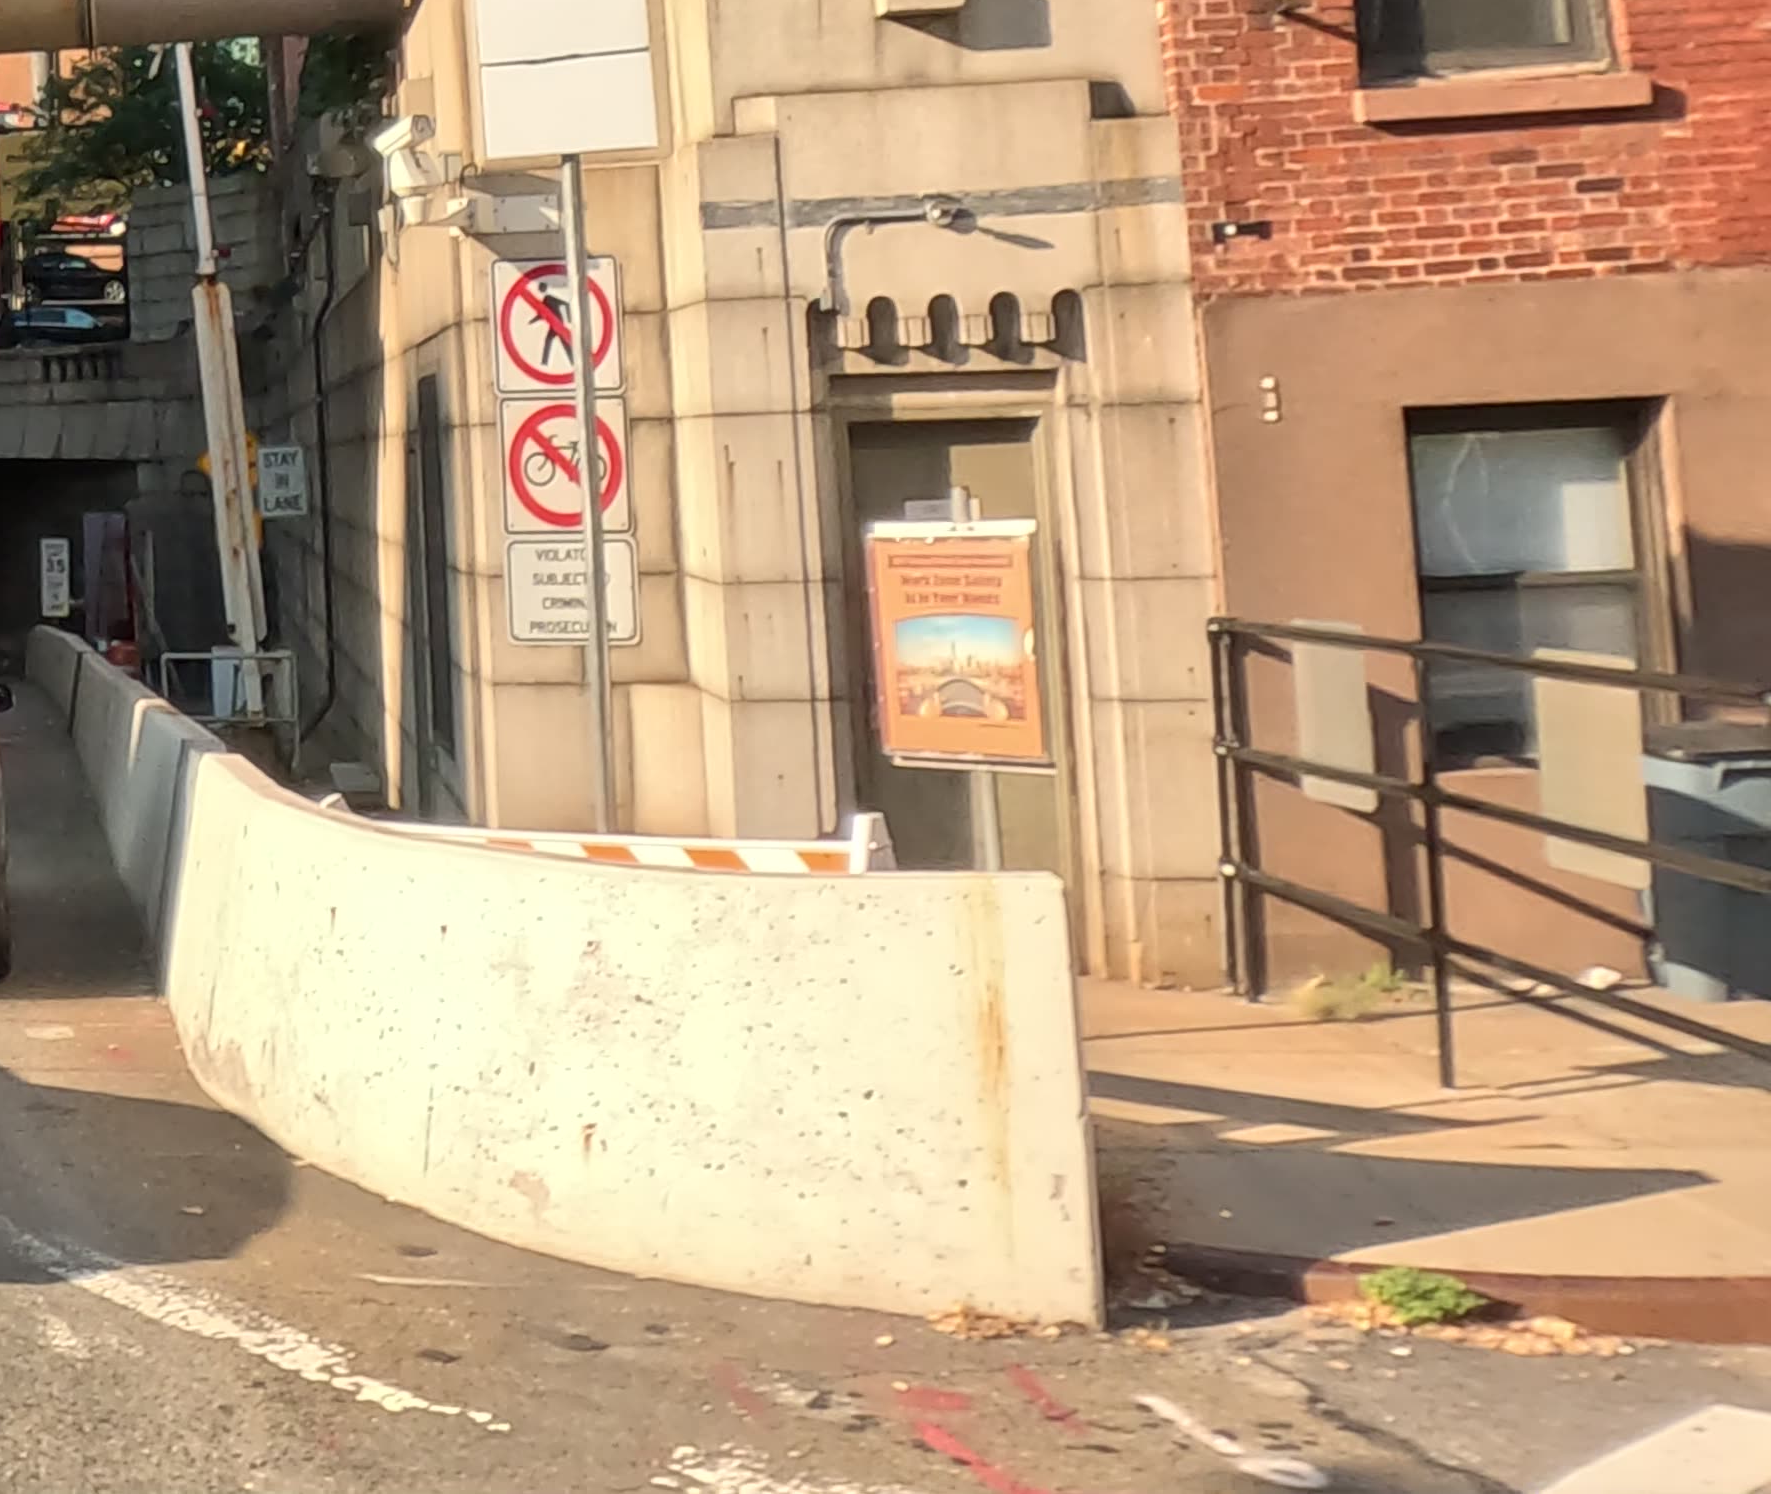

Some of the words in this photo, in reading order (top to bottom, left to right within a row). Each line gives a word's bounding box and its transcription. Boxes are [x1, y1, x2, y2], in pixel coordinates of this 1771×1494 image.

[262, 450, 299, 469] STAY
[274, 472, 289, 490] IN
[263, 493, 304, 513] LANE
